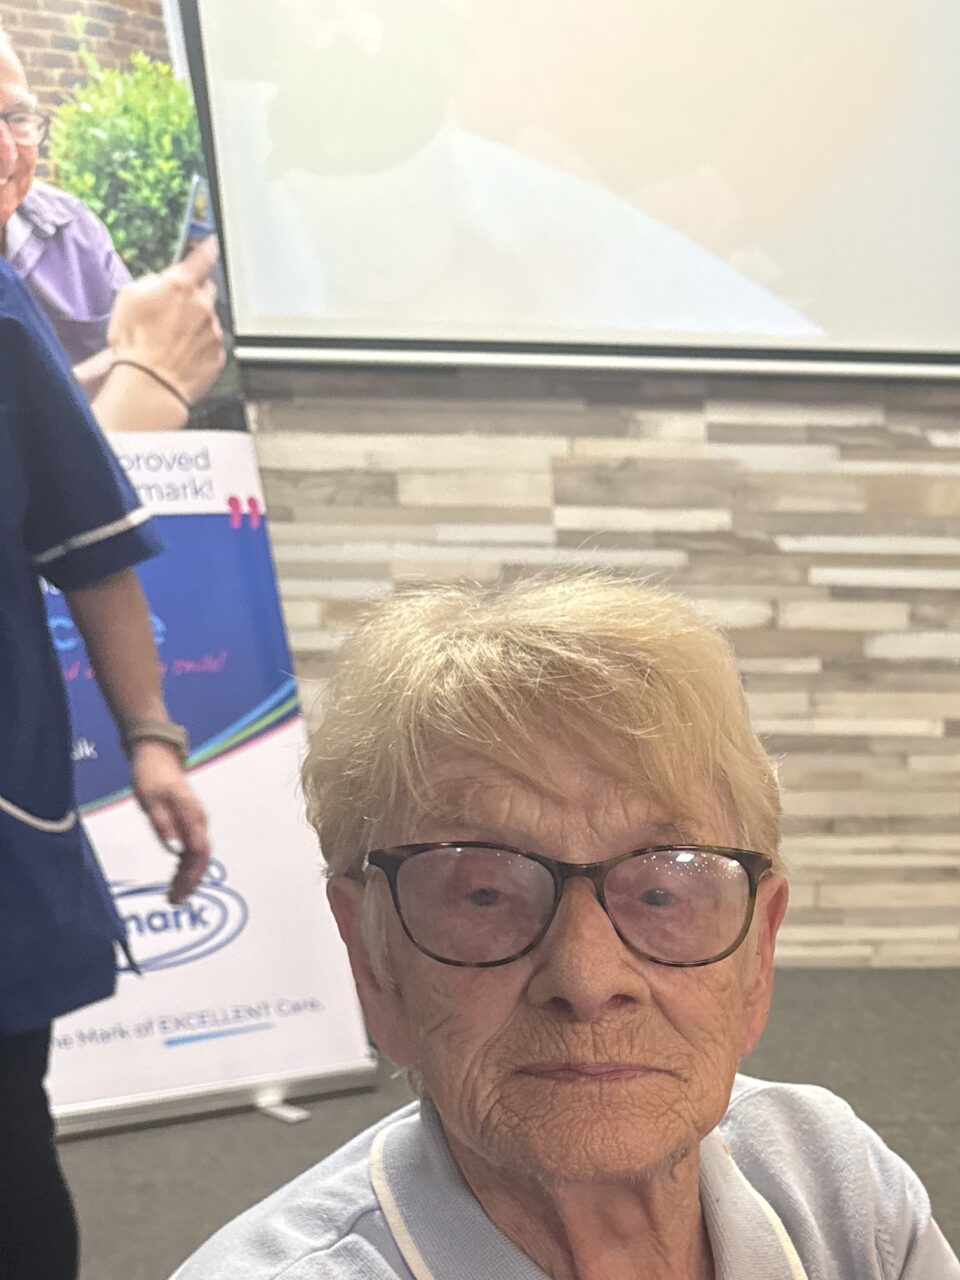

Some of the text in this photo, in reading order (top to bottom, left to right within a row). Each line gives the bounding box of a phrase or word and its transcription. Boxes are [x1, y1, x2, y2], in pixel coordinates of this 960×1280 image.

[76, 1023, 129, 1046] Mark
[134, 1018, 154, 1039] of
[157, 1001, 271, 1035] EXCELLENT
